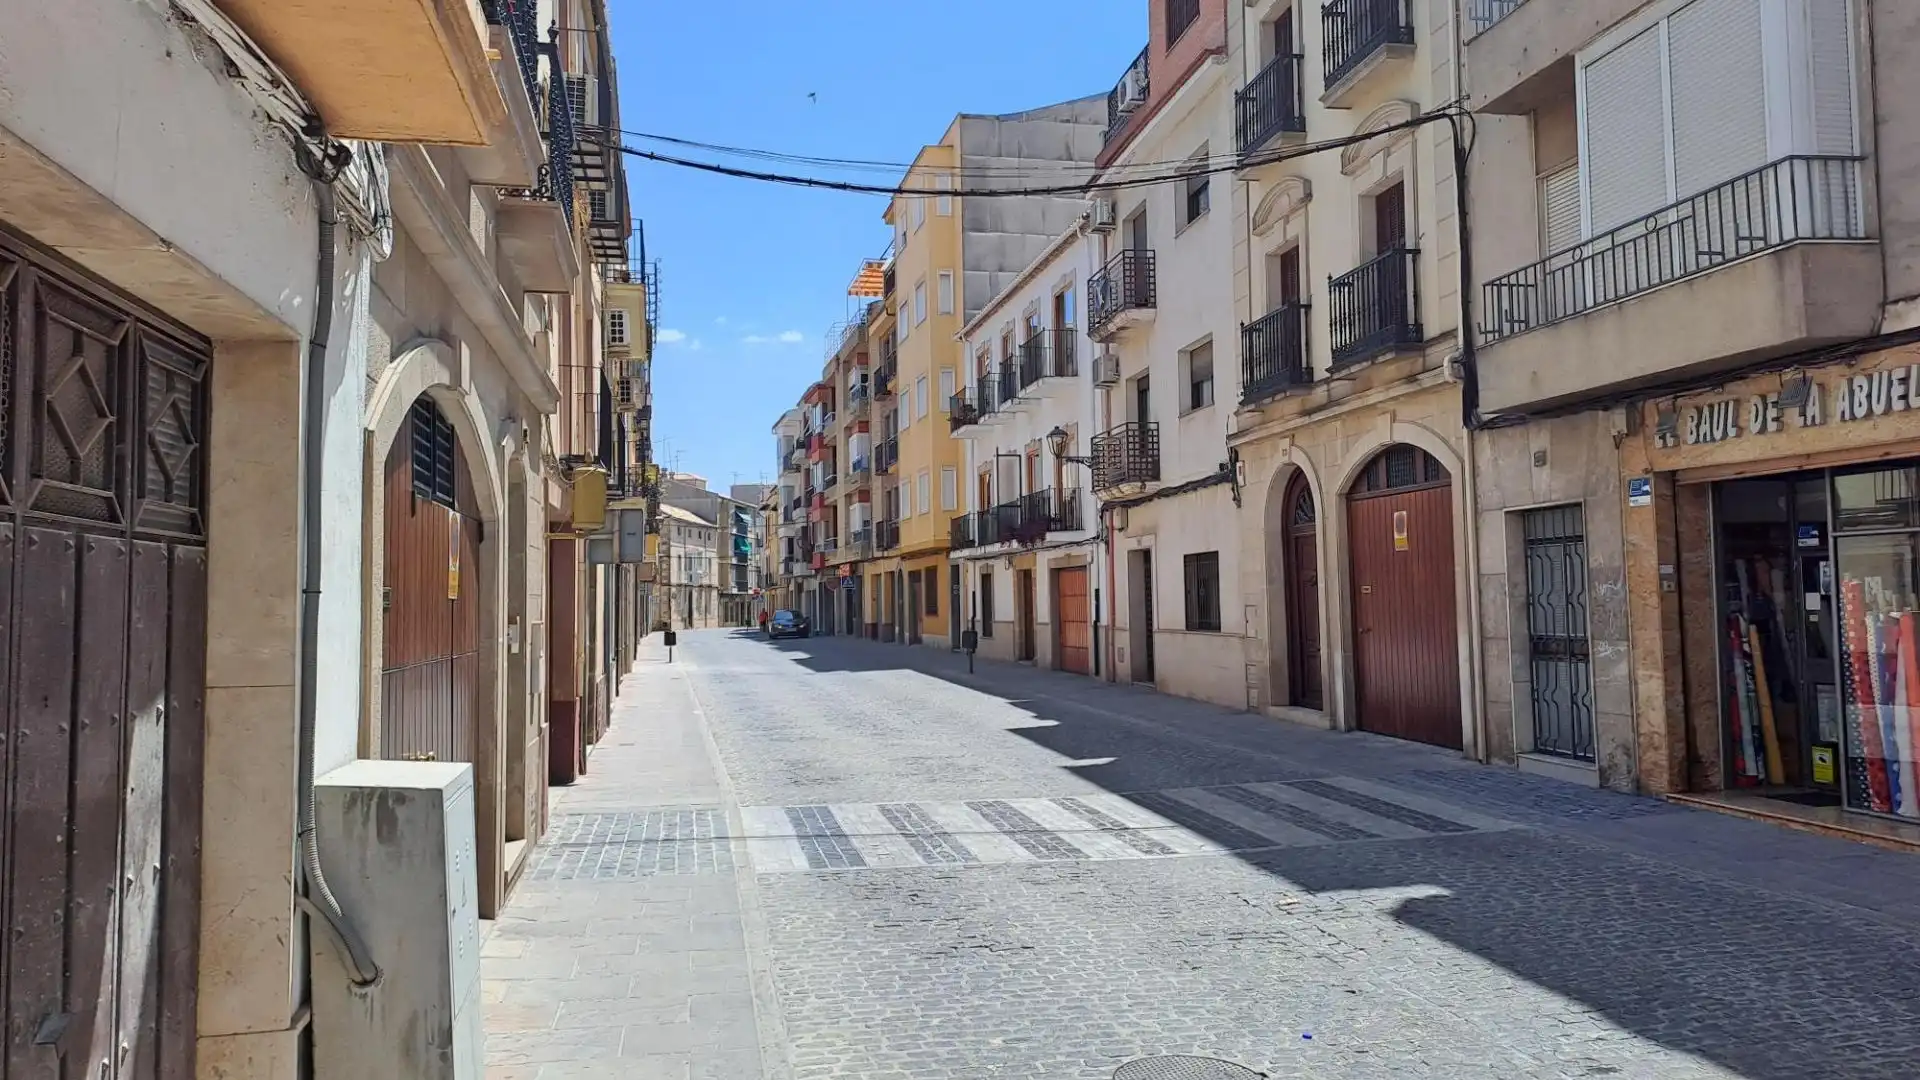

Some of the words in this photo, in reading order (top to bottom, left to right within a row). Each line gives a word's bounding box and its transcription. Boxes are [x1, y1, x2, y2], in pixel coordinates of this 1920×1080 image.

[1686, 400, 1736, 444] BAUL
[1750, 391, 1778, 434] DE
[1793, 382, 1821, 428] A
[1836, 364, 1920, 420] ABUEL
